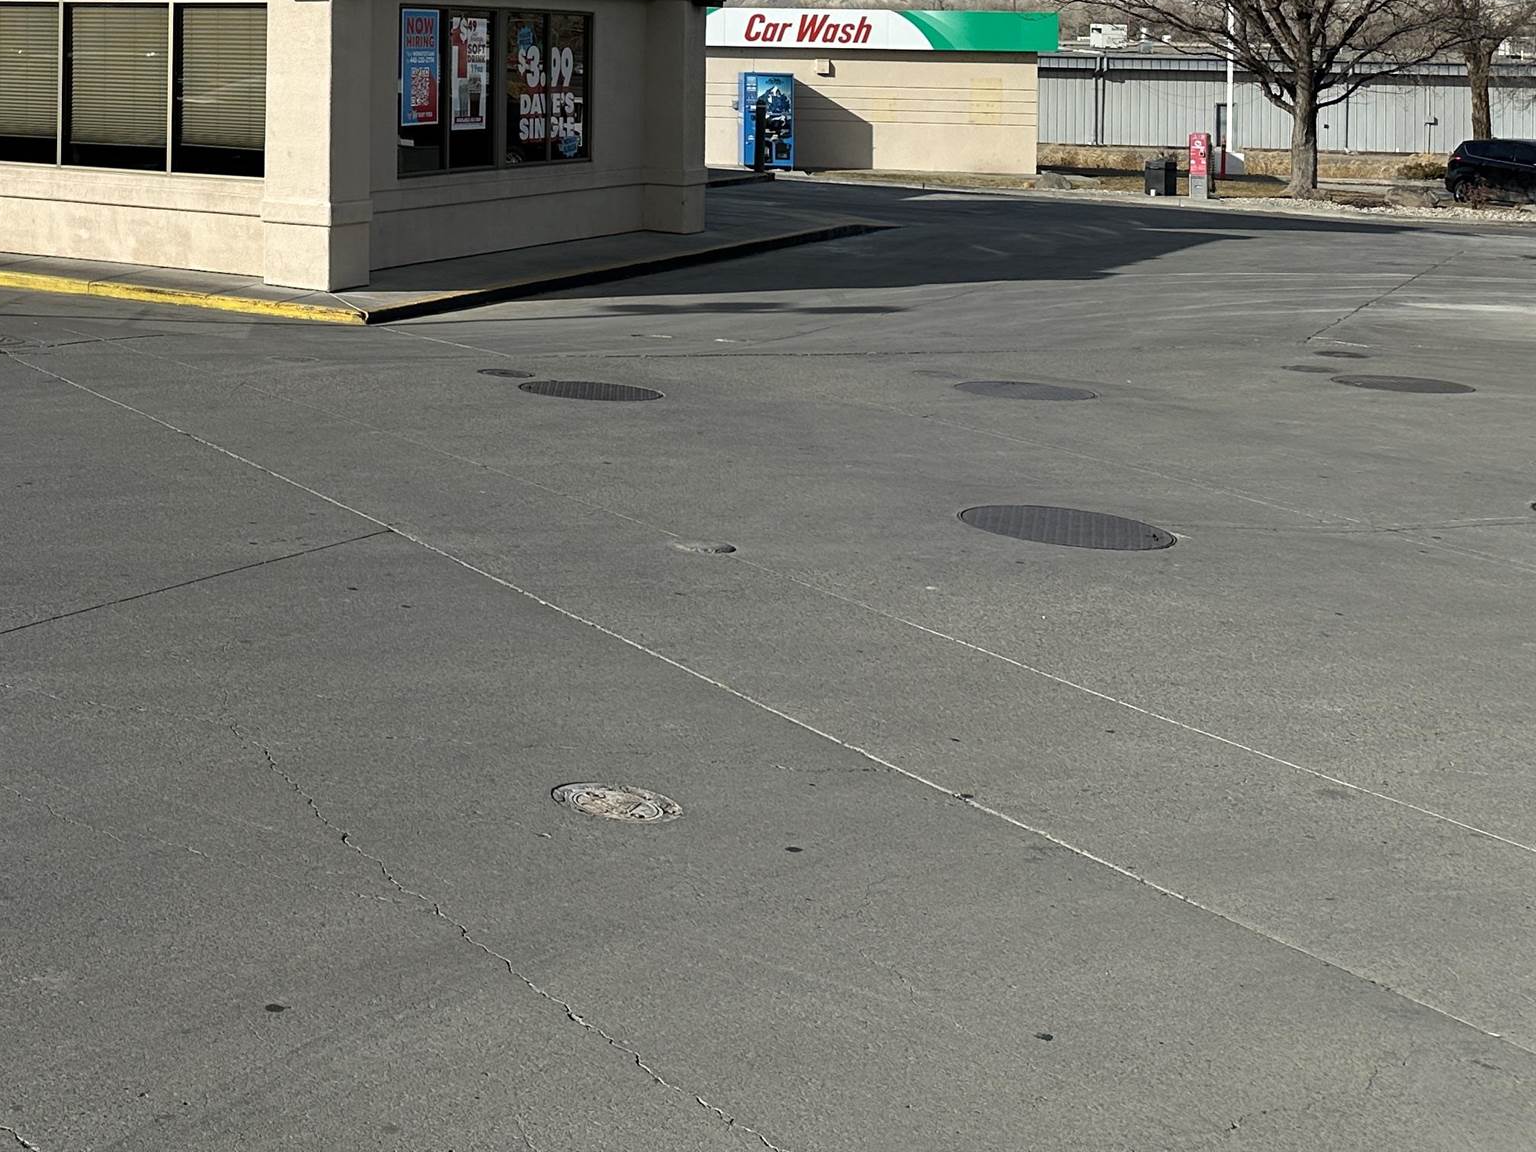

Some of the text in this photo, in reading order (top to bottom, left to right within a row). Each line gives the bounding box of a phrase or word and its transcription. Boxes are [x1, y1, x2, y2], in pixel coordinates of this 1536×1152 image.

[406, 17, 434, 35] NOW
[744, 13, 872, 44] Car Wash
[406, 35, 435, 48] HIRING
[467, 43, 485, 54] SOFT
[517, 45, 573, 88] $3.99
